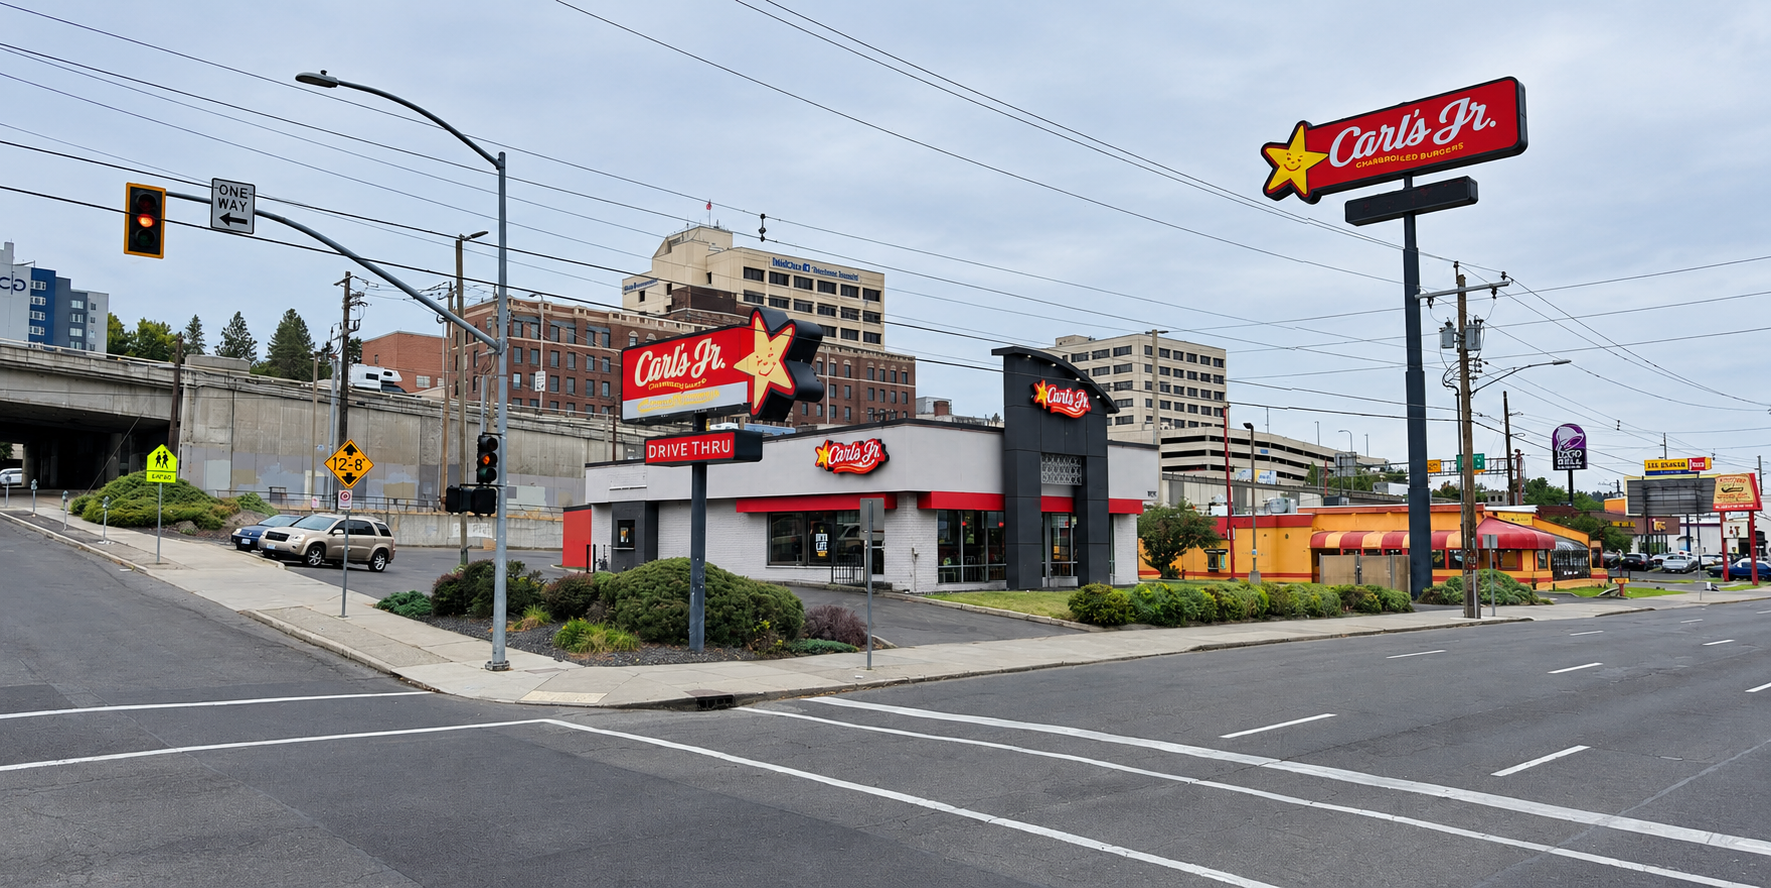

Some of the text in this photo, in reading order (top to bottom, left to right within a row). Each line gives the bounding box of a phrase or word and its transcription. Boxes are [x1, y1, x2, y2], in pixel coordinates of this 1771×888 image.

[1329, 97, 1497, 168] Carl's Jr.
[1420, 142, 1464, 160] BURGERS
[219, 184, 248, 199] ONE
[217, 197, 247, 212] WAY
[634, 337, 726, 387] Carl's Jr.
[648, 439, 731, 459] DRIVE THRU
[861, 441, 880, 463] Jr.
